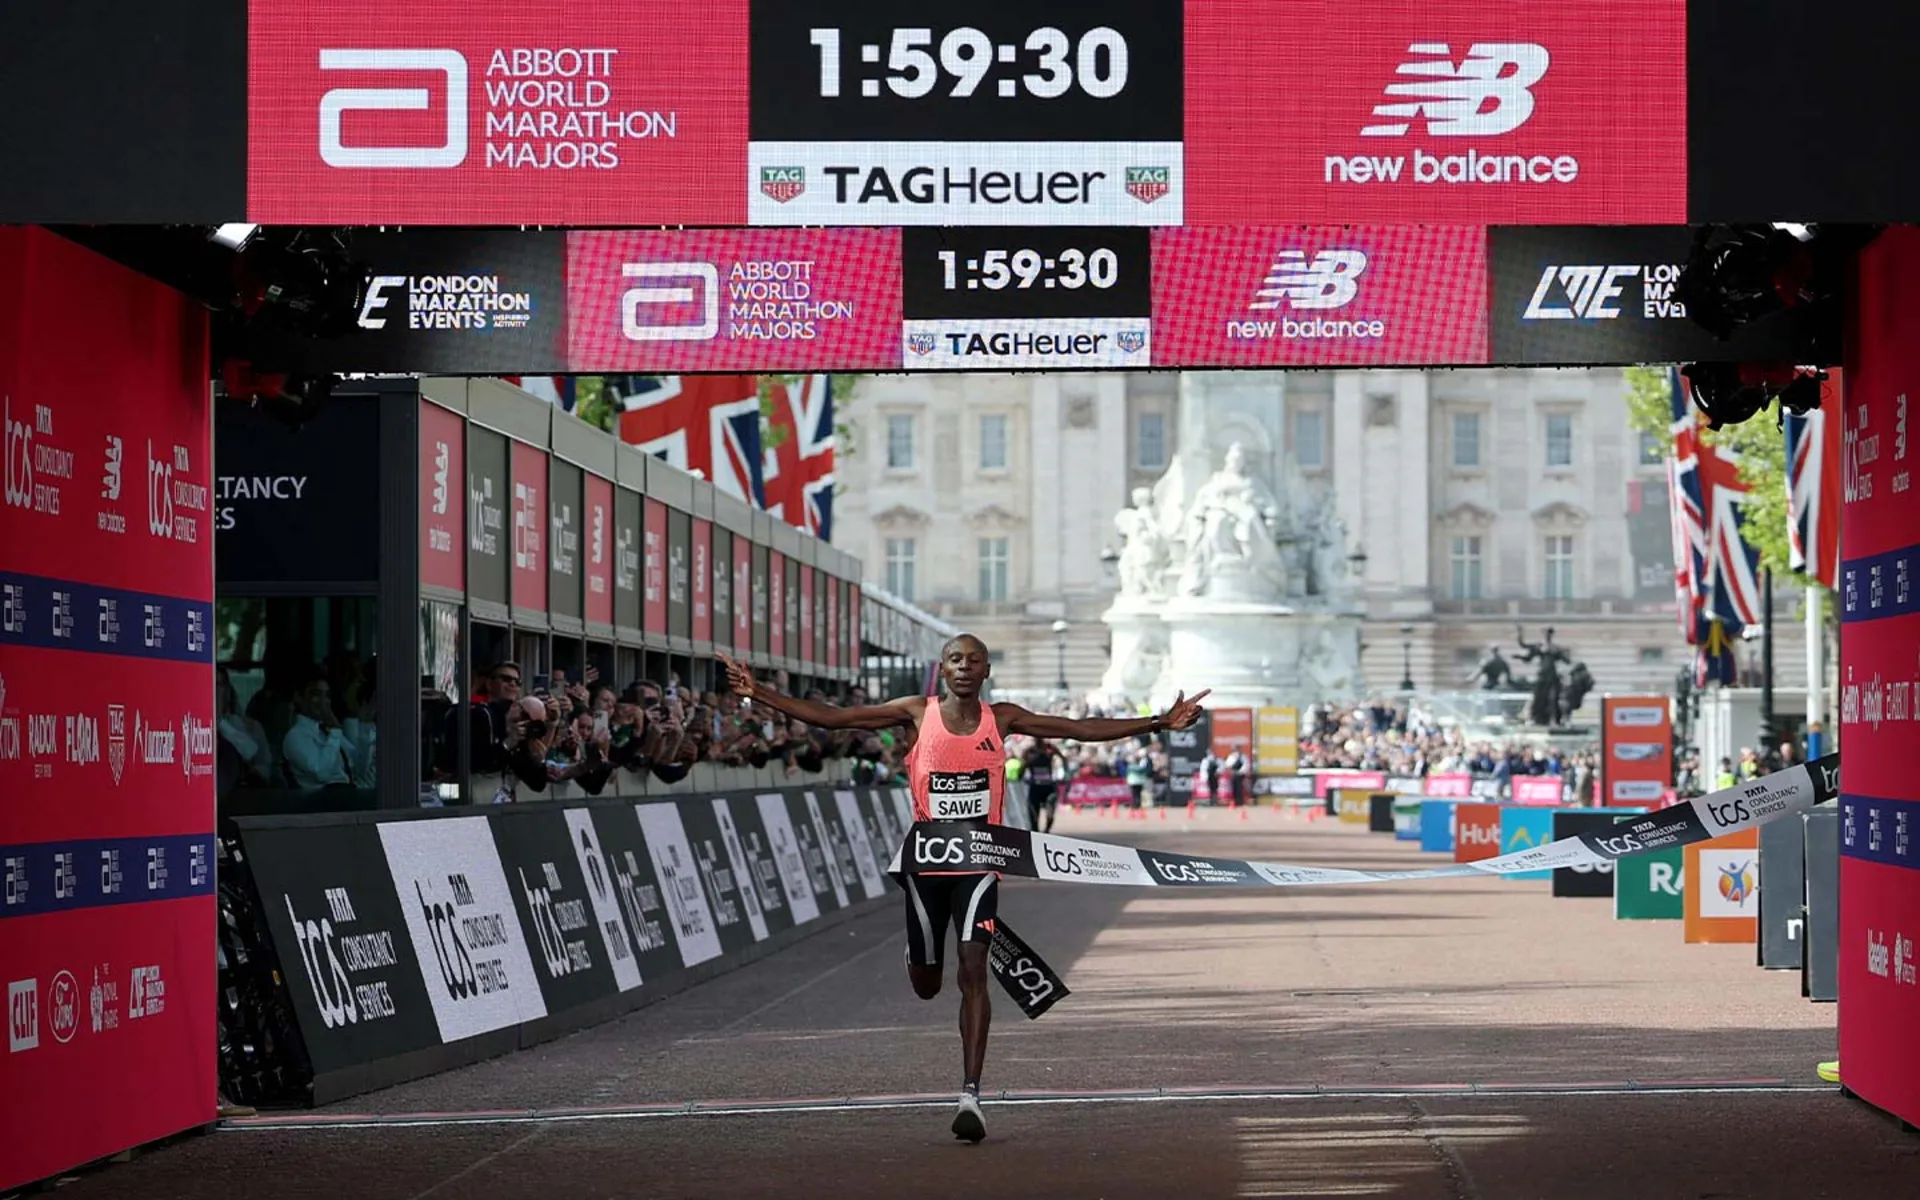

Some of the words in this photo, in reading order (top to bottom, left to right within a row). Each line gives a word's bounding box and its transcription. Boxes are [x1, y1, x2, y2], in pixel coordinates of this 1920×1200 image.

[486, 48, 618, 77] ABBOTT
[810, 26, 1129, 98] 1:59:30
[485, 80, 610, 108] WORLD
[485, 111, 676, 138] MARATHON
[485, 142, 619, 169] MAJORS
[1325, 154, 1404, 183] new
[1414, 149, 1578, 183] balance
[765, 169, 801, 181] TAG
[1131, 169, 1166, 181] TAG
[729, 261, 815, 280] ABBOTT
[938, 248, 1119, 290] 1:59:30
[409, 276, 499, 293] LONDON
[728, 281, 811, 300] WORLD
[357, 276, 406, 329] E
[409, 293, 530, 311] MARATHON
[729, 301, 853, 320] MARATHON
[409, 311, 486, 329] EVENTS
[729, 321, 816, 341] MAJORS
[1227, 321, 1277, 338] new
[1282, 317, 1385, 339] balance
[5, 395, 32, 509] tcs
[148, 438, 173, 538] tcs
[28, 715, 57, 759] RADOX
[66, 712, 100, 766] FLORA
[931, 775, 955, 790] tcs
[1744, 785, 1768, 799] TATA
[938, 799, 982, 816] SAWE
[1748, 785, 1799, 808] CONSULTANCY
[1707, 799, 1750, 827] tcs
[1753, 800, 1787, 818] SERVICES
[969, 831, 993, 843] TATA
[1631, 821, 1656, 833] TATA
[1638, 820, 1689, 841] CONSULTANCY
[915, 830, 964, 864] tcs
[970, 841, 1021, 859] CONSULTANCY
[1595, 833, 1643, 855] tcs
[1644, 835, 1678, 848] SERVICES
[970, 854, 1007, 867] SERVICES
[1043, 842, 1082, 876] tcs
[1078, 848, 1101, 859] TATA
[1081, 858, 1133, 871] CONSULTANCY
[1085, 868, 1121, 879] SERVICES
[1152, 858, 1200, 882] tcs
[448, 873, 475, 906] TATA
[324, 887, 357, 923] TATA
[518, 866, 571, 978] tcs
[340, 931, 399, 972] CONSULTANCY
[414, 879, 478, 1001] tcs
[284, 893, 357, 1029] tcs
[1009, 957, 1054, 1007] tcs
[356, 981, 396, 1021] SERVICES
[13, 990, 37, 1041] CLIF
